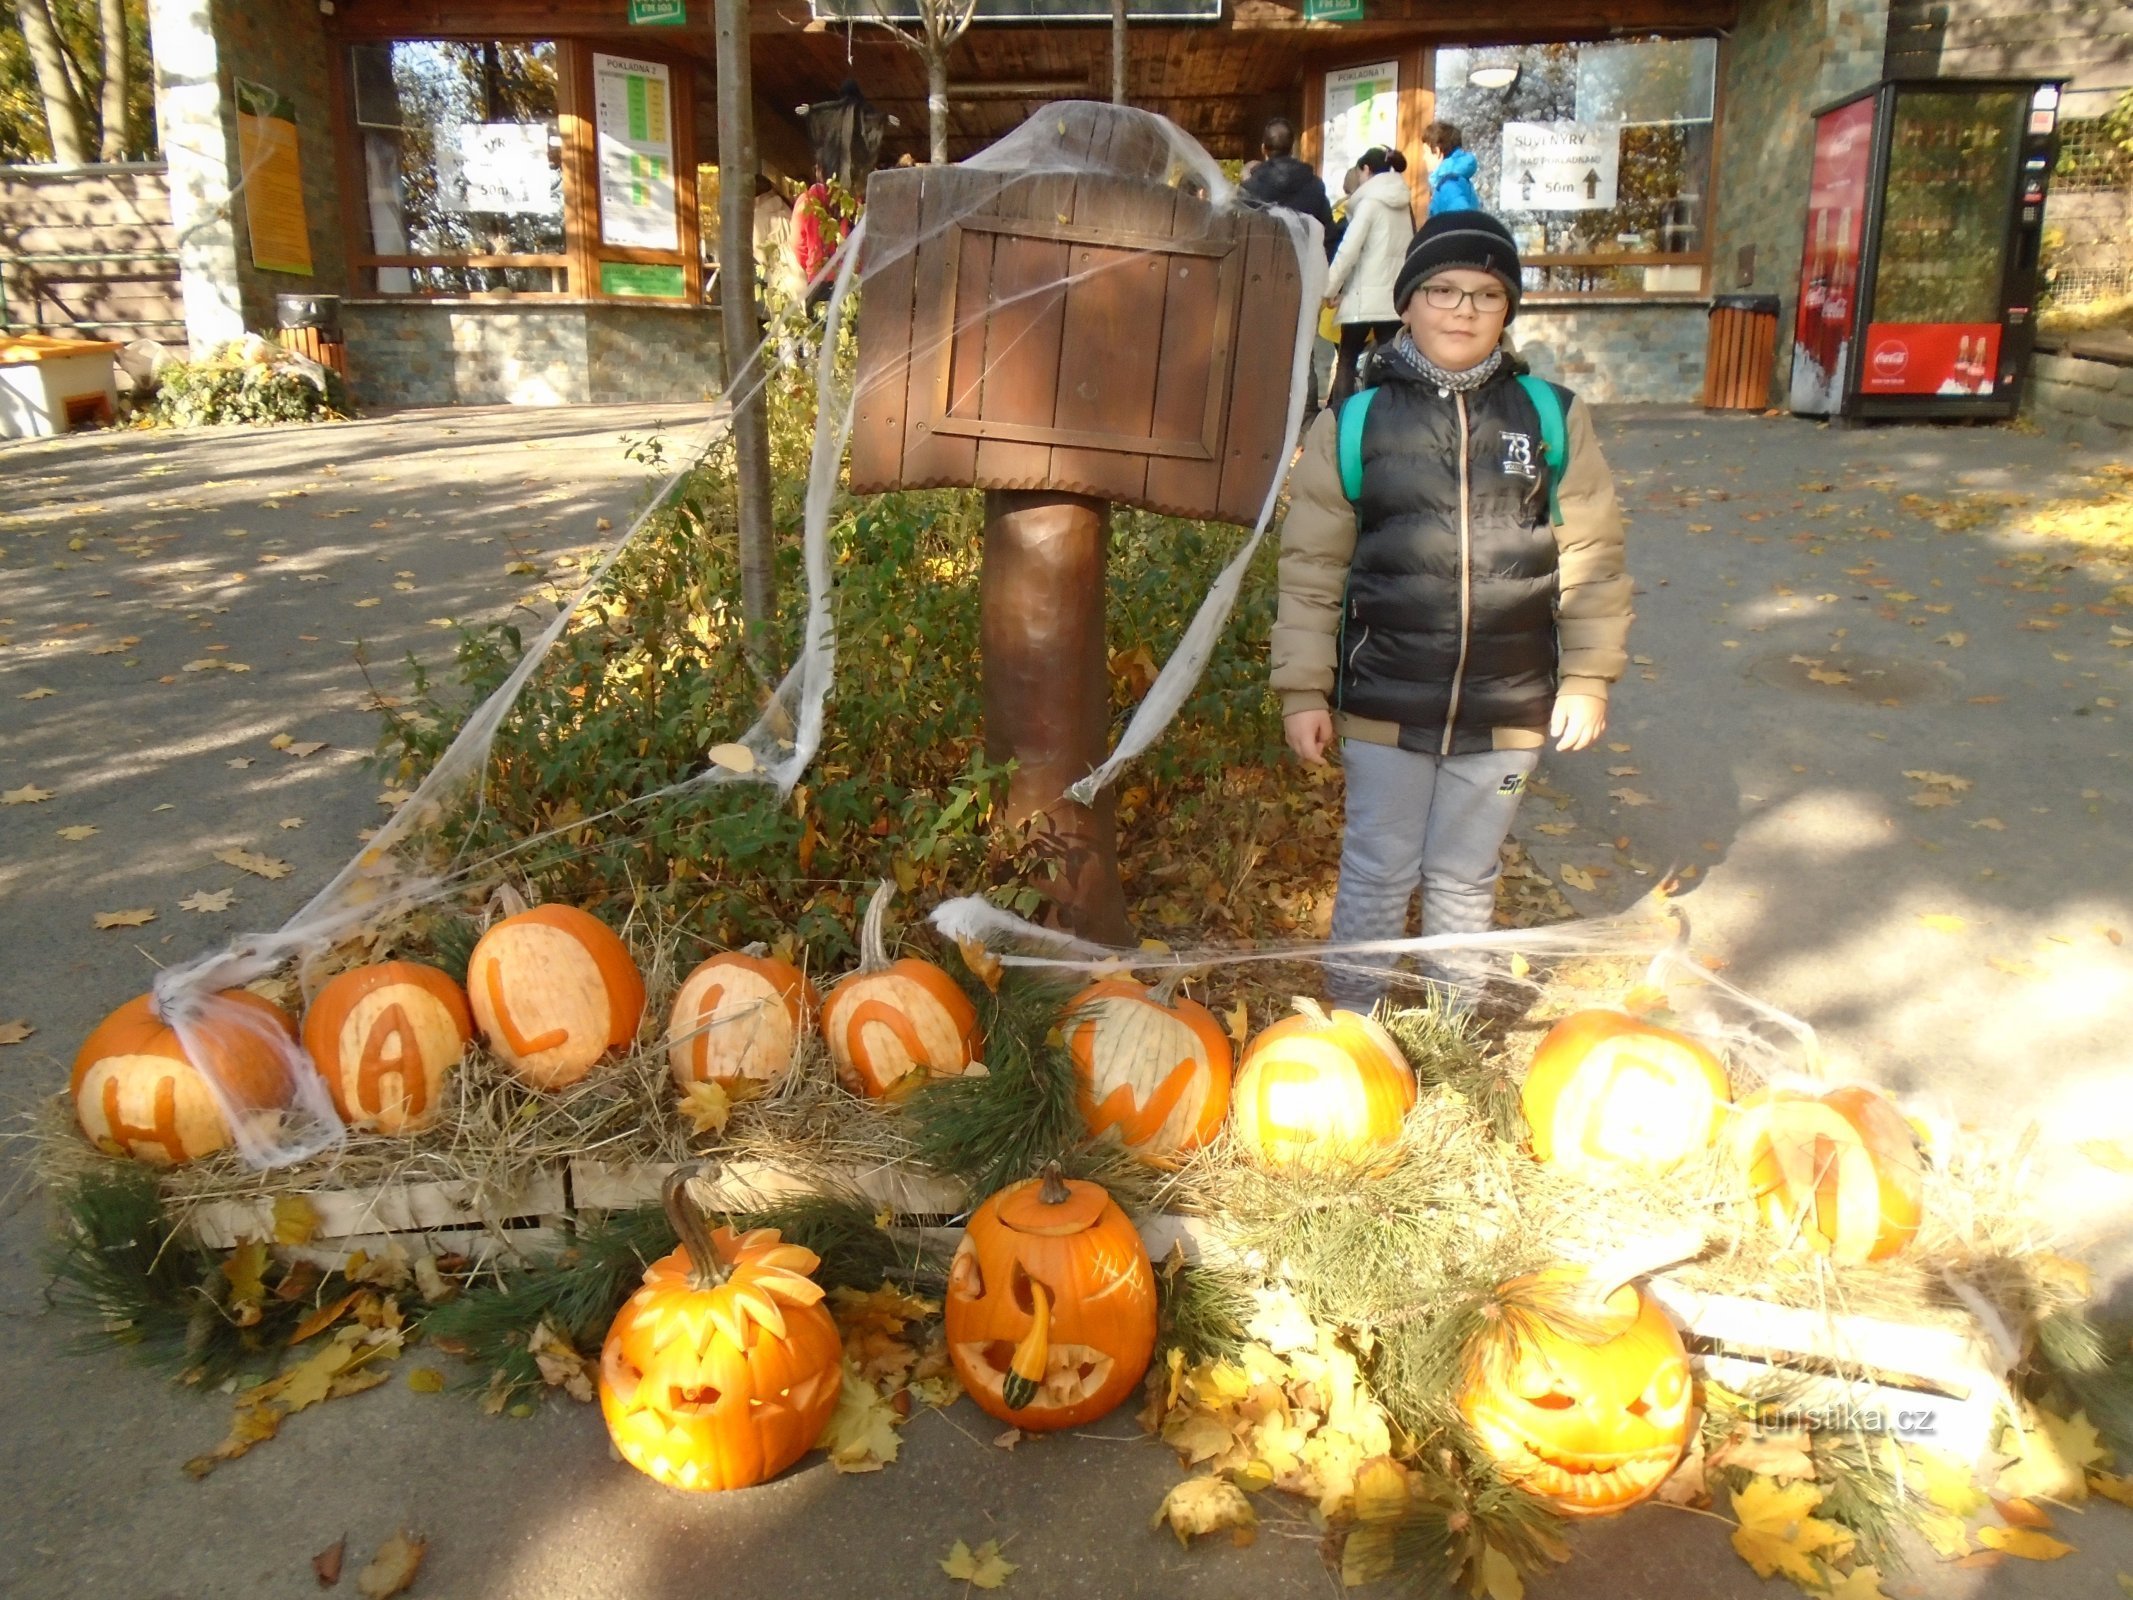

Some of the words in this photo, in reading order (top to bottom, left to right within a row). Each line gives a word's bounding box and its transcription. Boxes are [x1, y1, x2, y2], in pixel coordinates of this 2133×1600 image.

[606, 59, 650, 74] POKLADNA
[651, 66, 657, 75] 2
[1338, 68, 1379, 81] POKLADNA
[1545, 181, 1575, 194] 50m
